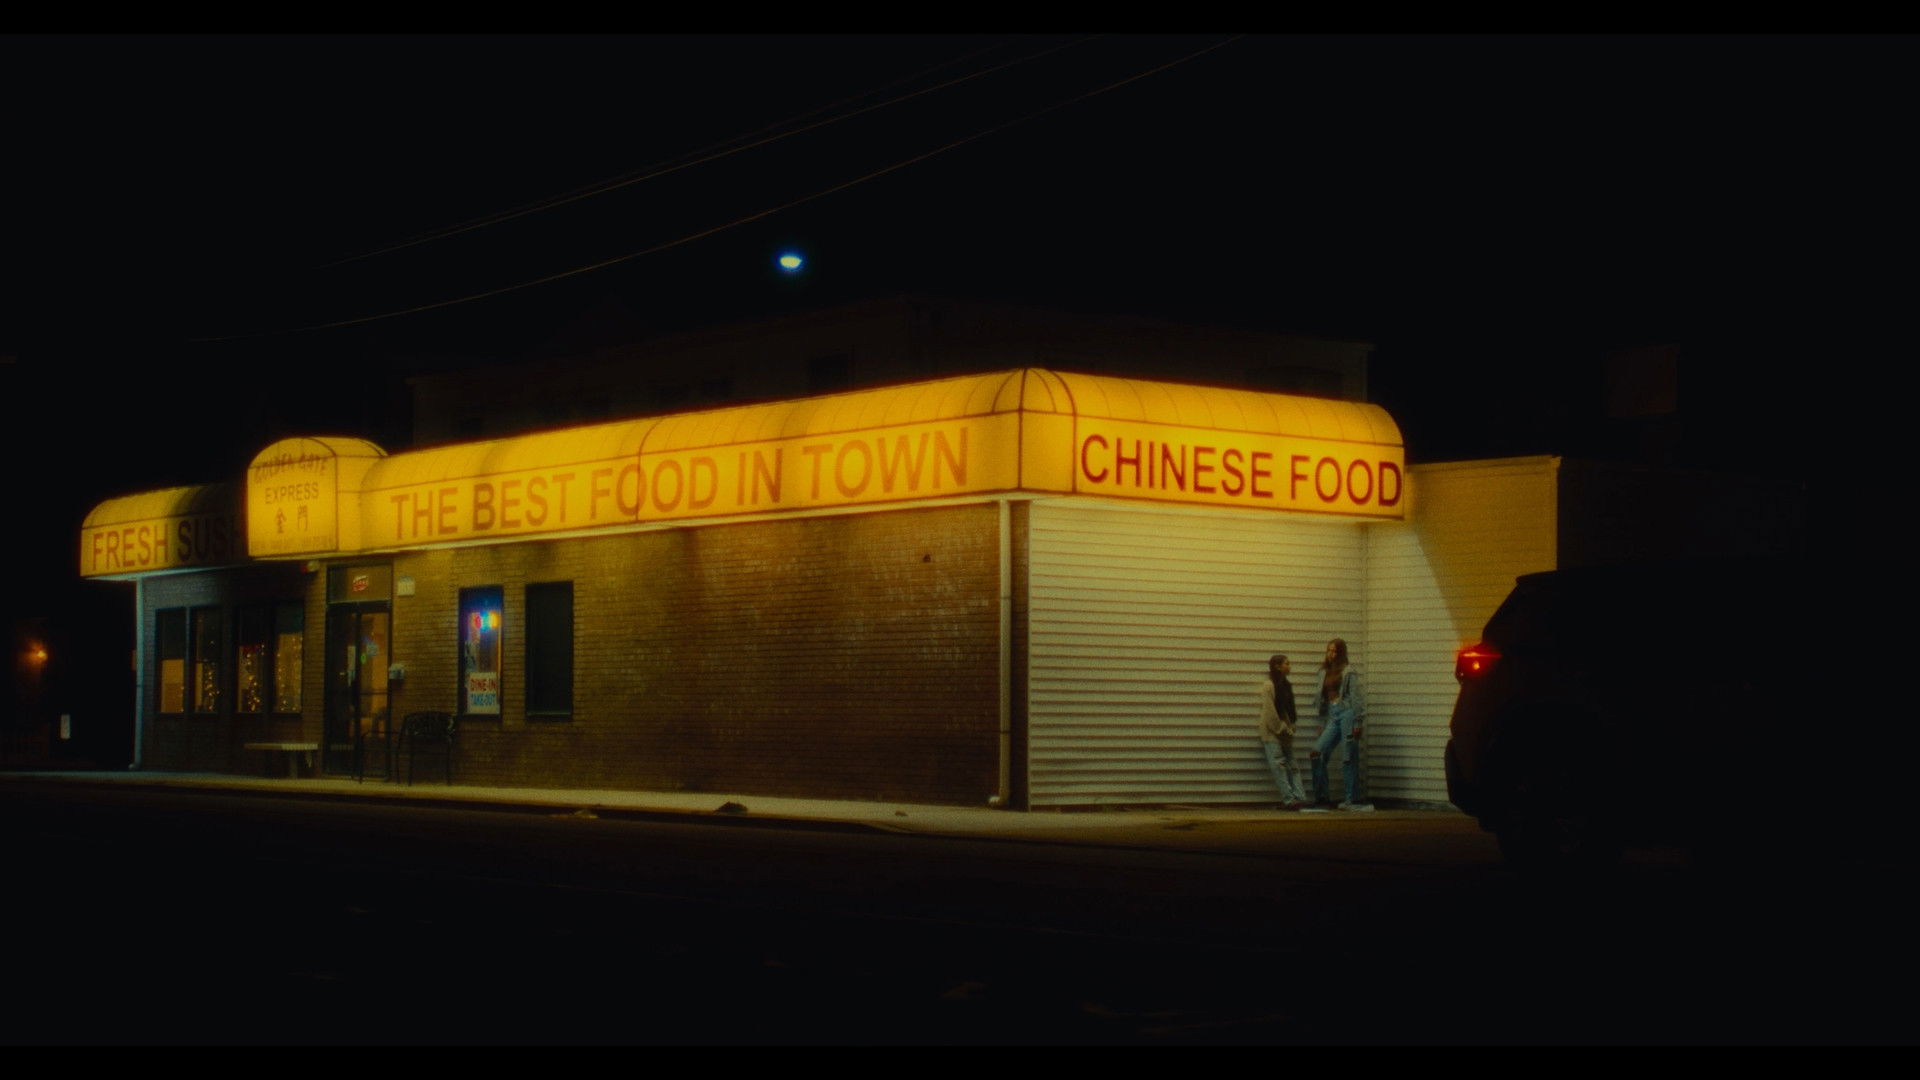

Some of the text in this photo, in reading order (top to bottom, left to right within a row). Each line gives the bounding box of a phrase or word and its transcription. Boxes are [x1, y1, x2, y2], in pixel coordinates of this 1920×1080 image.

[265, 481, 320, 505] EXPRESS
[391, 427, 970, 538] THE BEST FOOD IN TOWN
[1081, 434, 1402, 507] CHINESE FOOD
[92, 515, 246, 572] FRESH SUSH
